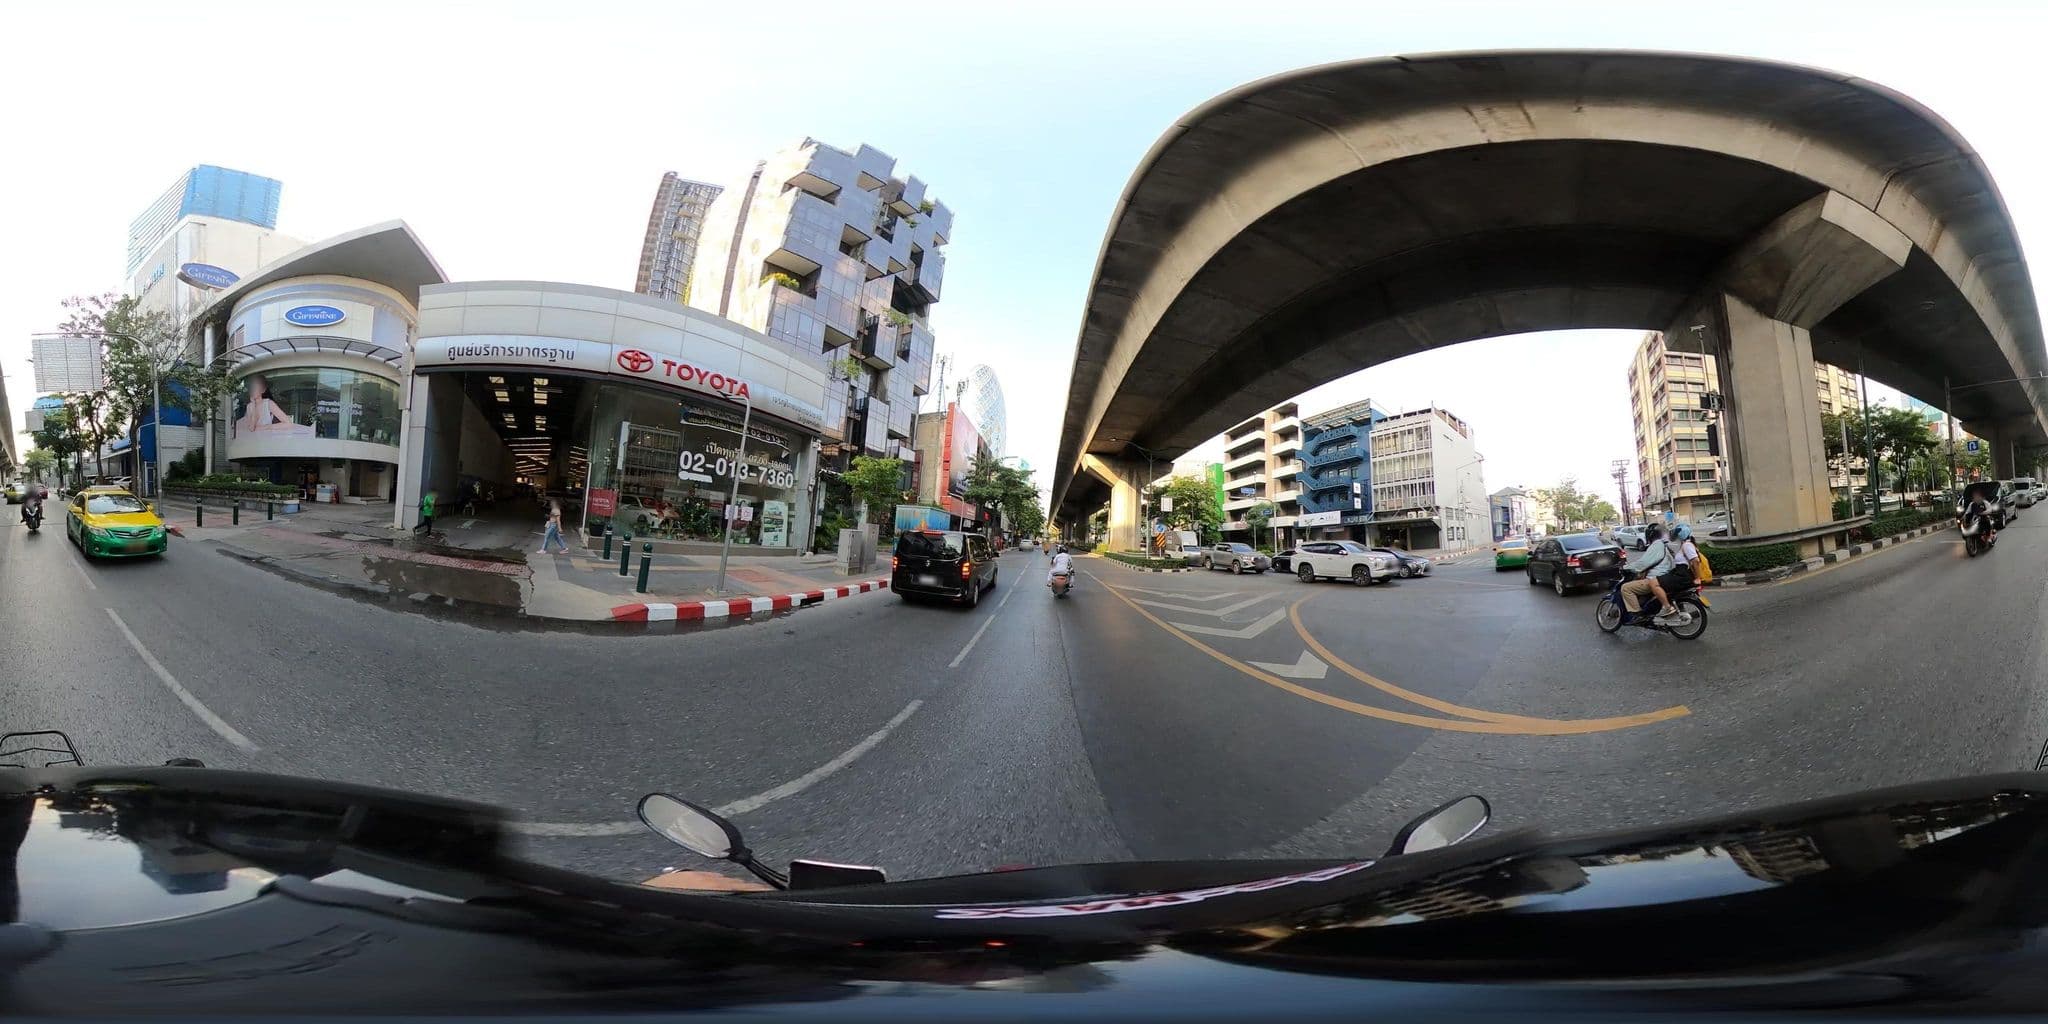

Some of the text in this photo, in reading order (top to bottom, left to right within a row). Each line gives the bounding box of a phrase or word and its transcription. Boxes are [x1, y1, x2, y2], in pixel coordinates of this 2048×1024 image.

[447, 342, 575, 363] ศูนย์บริการมาตรฐาน
[662, 359, 750, 400] TOYOTA
[680, 450, 795, 489] 02-013-7360
